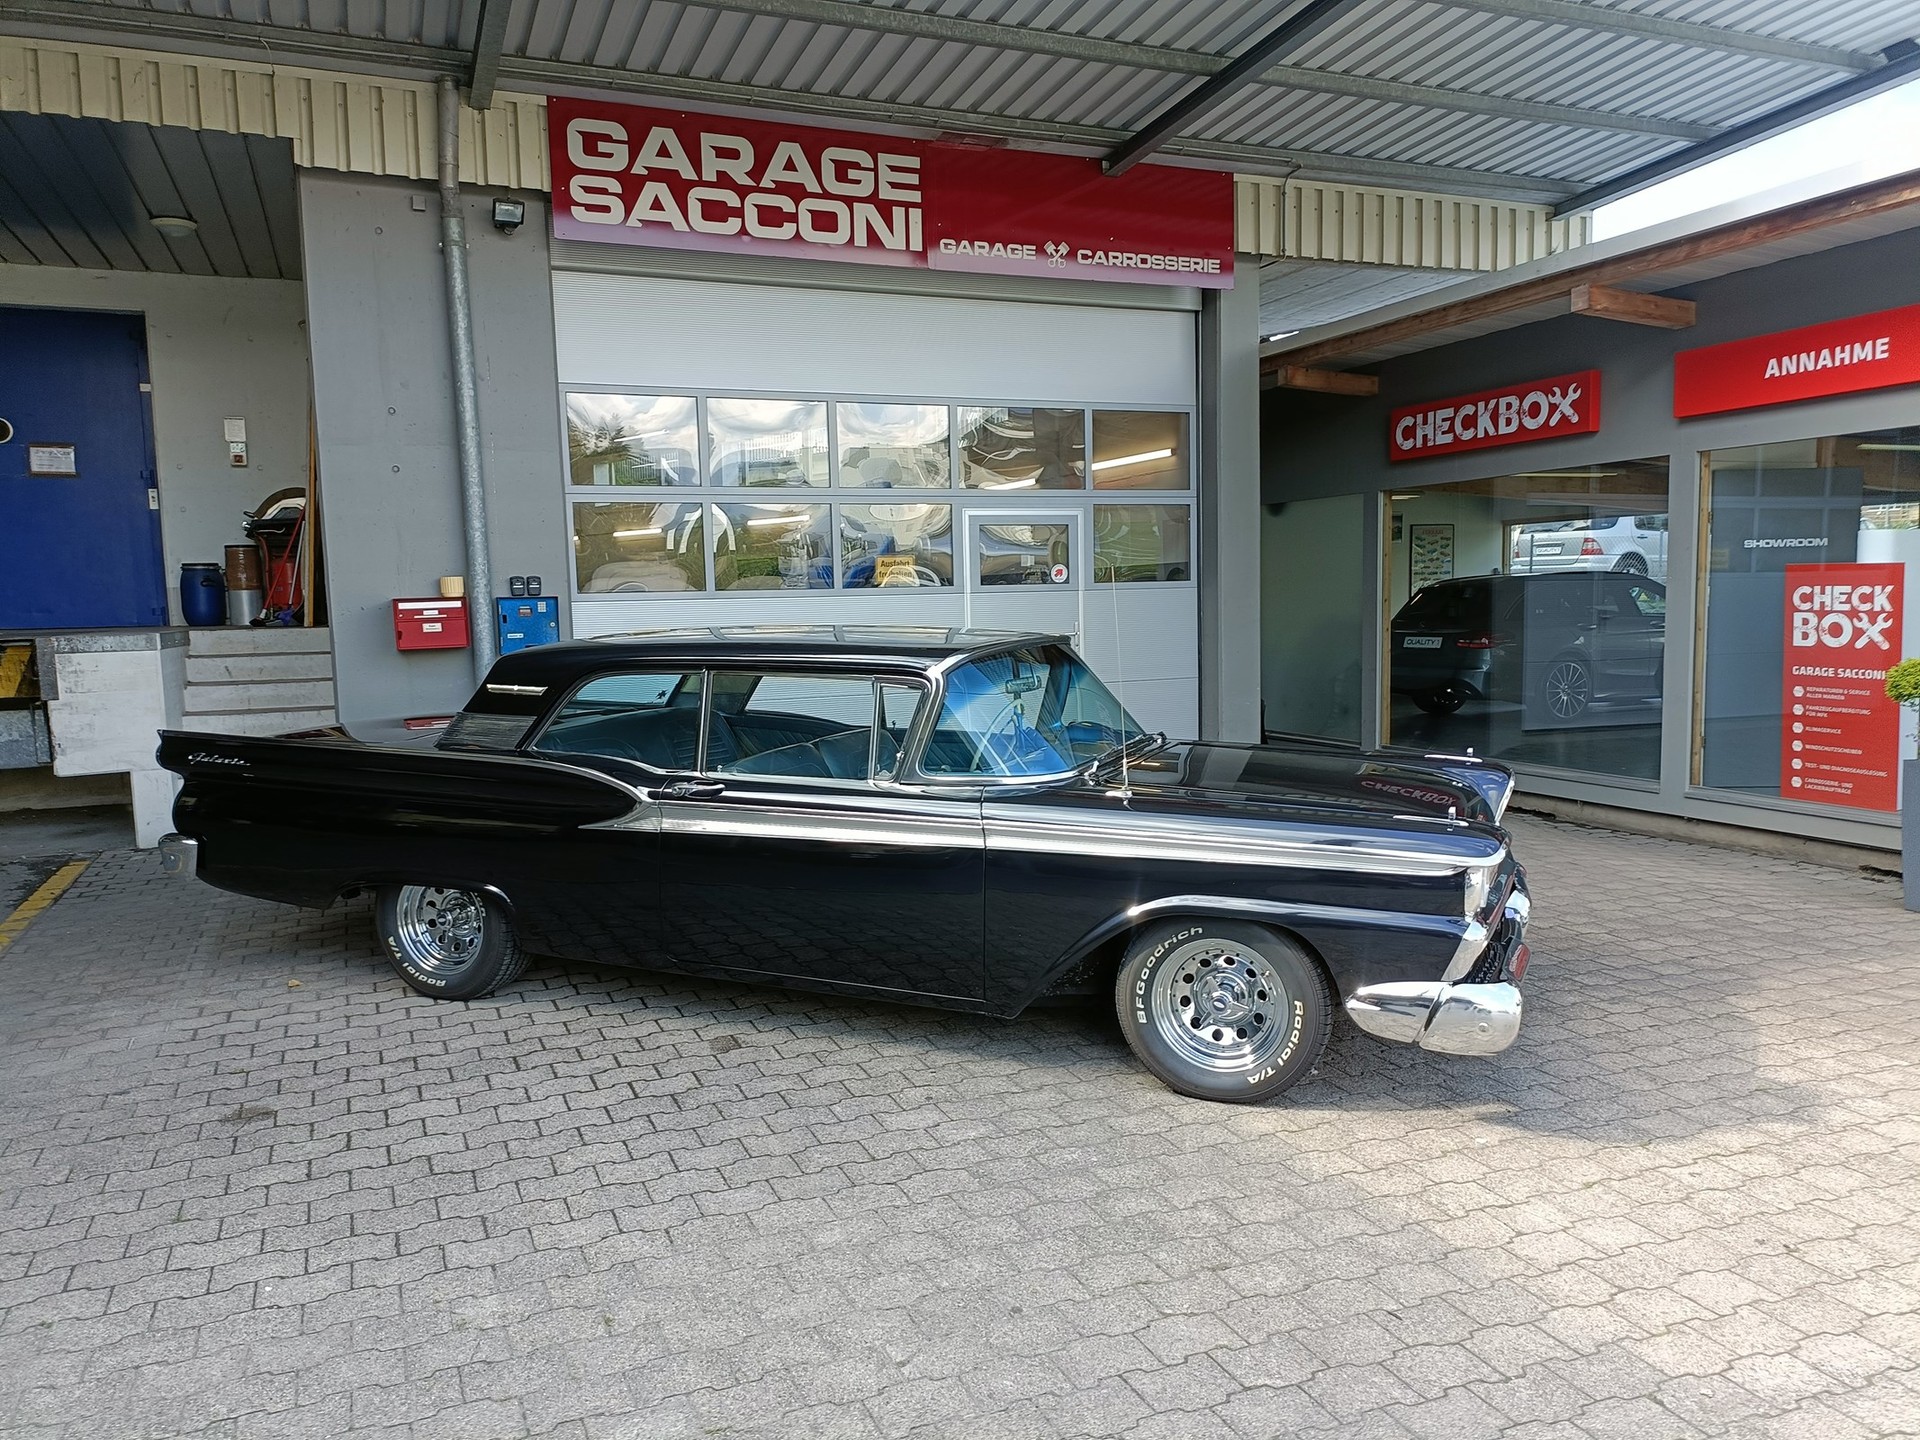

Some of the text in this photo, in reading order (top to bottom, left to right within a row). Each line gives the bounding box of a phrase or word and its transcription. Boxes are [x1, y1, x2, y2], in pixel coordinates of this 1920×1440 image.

[566, 117, 922, 203] GARAGE
[569, 173, 923, 252] SACCONI
[938, 238, 1221, 274] GARAGE CARROSSERIE
[1763, 336, 1890, 379] ANNAHME
[1395, 382, 1582, 450] CHECKBOX
[1743, 537, 1829, 549] SHOWROOM
[1792, 585, 1895, 612] CHECK
[1792, 611, 1894, 651] BOX
[1792, 666, 1886, 680] GARAGE SACCONI
[387, 936, 447, 987] Radial T/A
[1136, 926, 1203, 1024] BFGoodrich
[1246, 1000, 1304, 1085] Radial T/A
